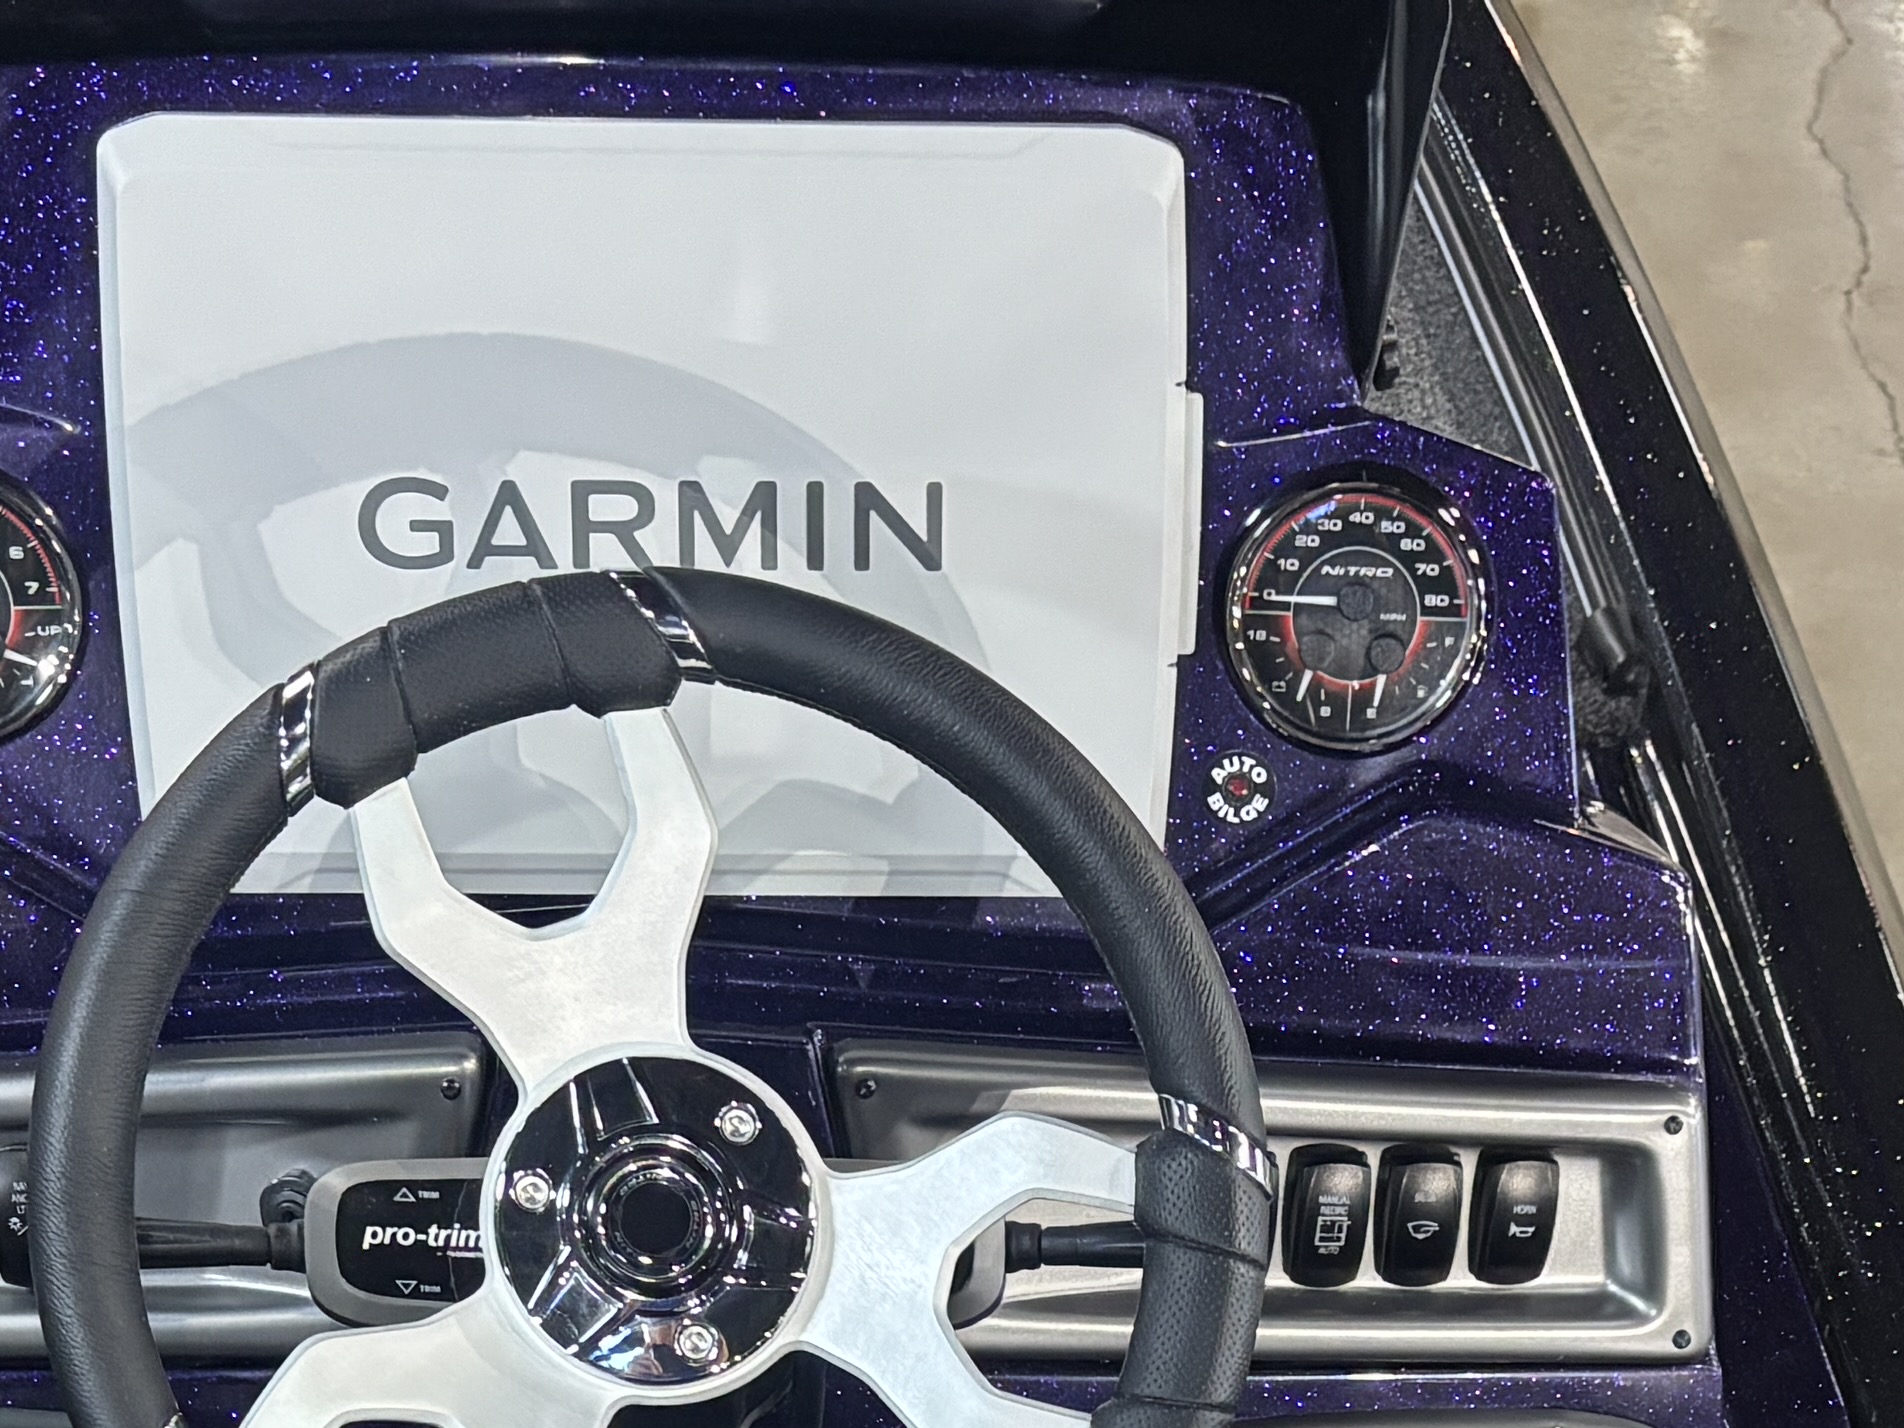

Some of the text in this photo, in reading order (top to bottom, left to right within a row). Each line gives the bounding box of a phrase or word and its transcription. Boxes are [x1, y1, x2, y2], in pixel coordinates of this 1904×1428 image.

[357, 475, 944, 572] GARMIN
[1349, 511, 1374, 524] 40
[1317, 519, 1343, 531] 30
[1380, 520, 1406, 533] 50
[1295, 534, 1320, 547] 20
[8, 546, 25, 560] 6
[1277, 558, 1300, 571] 10
[1321, 564, 1394, 577] NITRO
[1414, 563, 1440, 576] 70
[24, 581, 40, 595] 7
[1424, 594, 1450, 607] 80
[36, 625, 63, 636] UP
[1211, 755, 1267, 785] AUTO
[1207, 792, 1269, 823] BILGE
[362, 1223, 484, 1250] pro-trim
